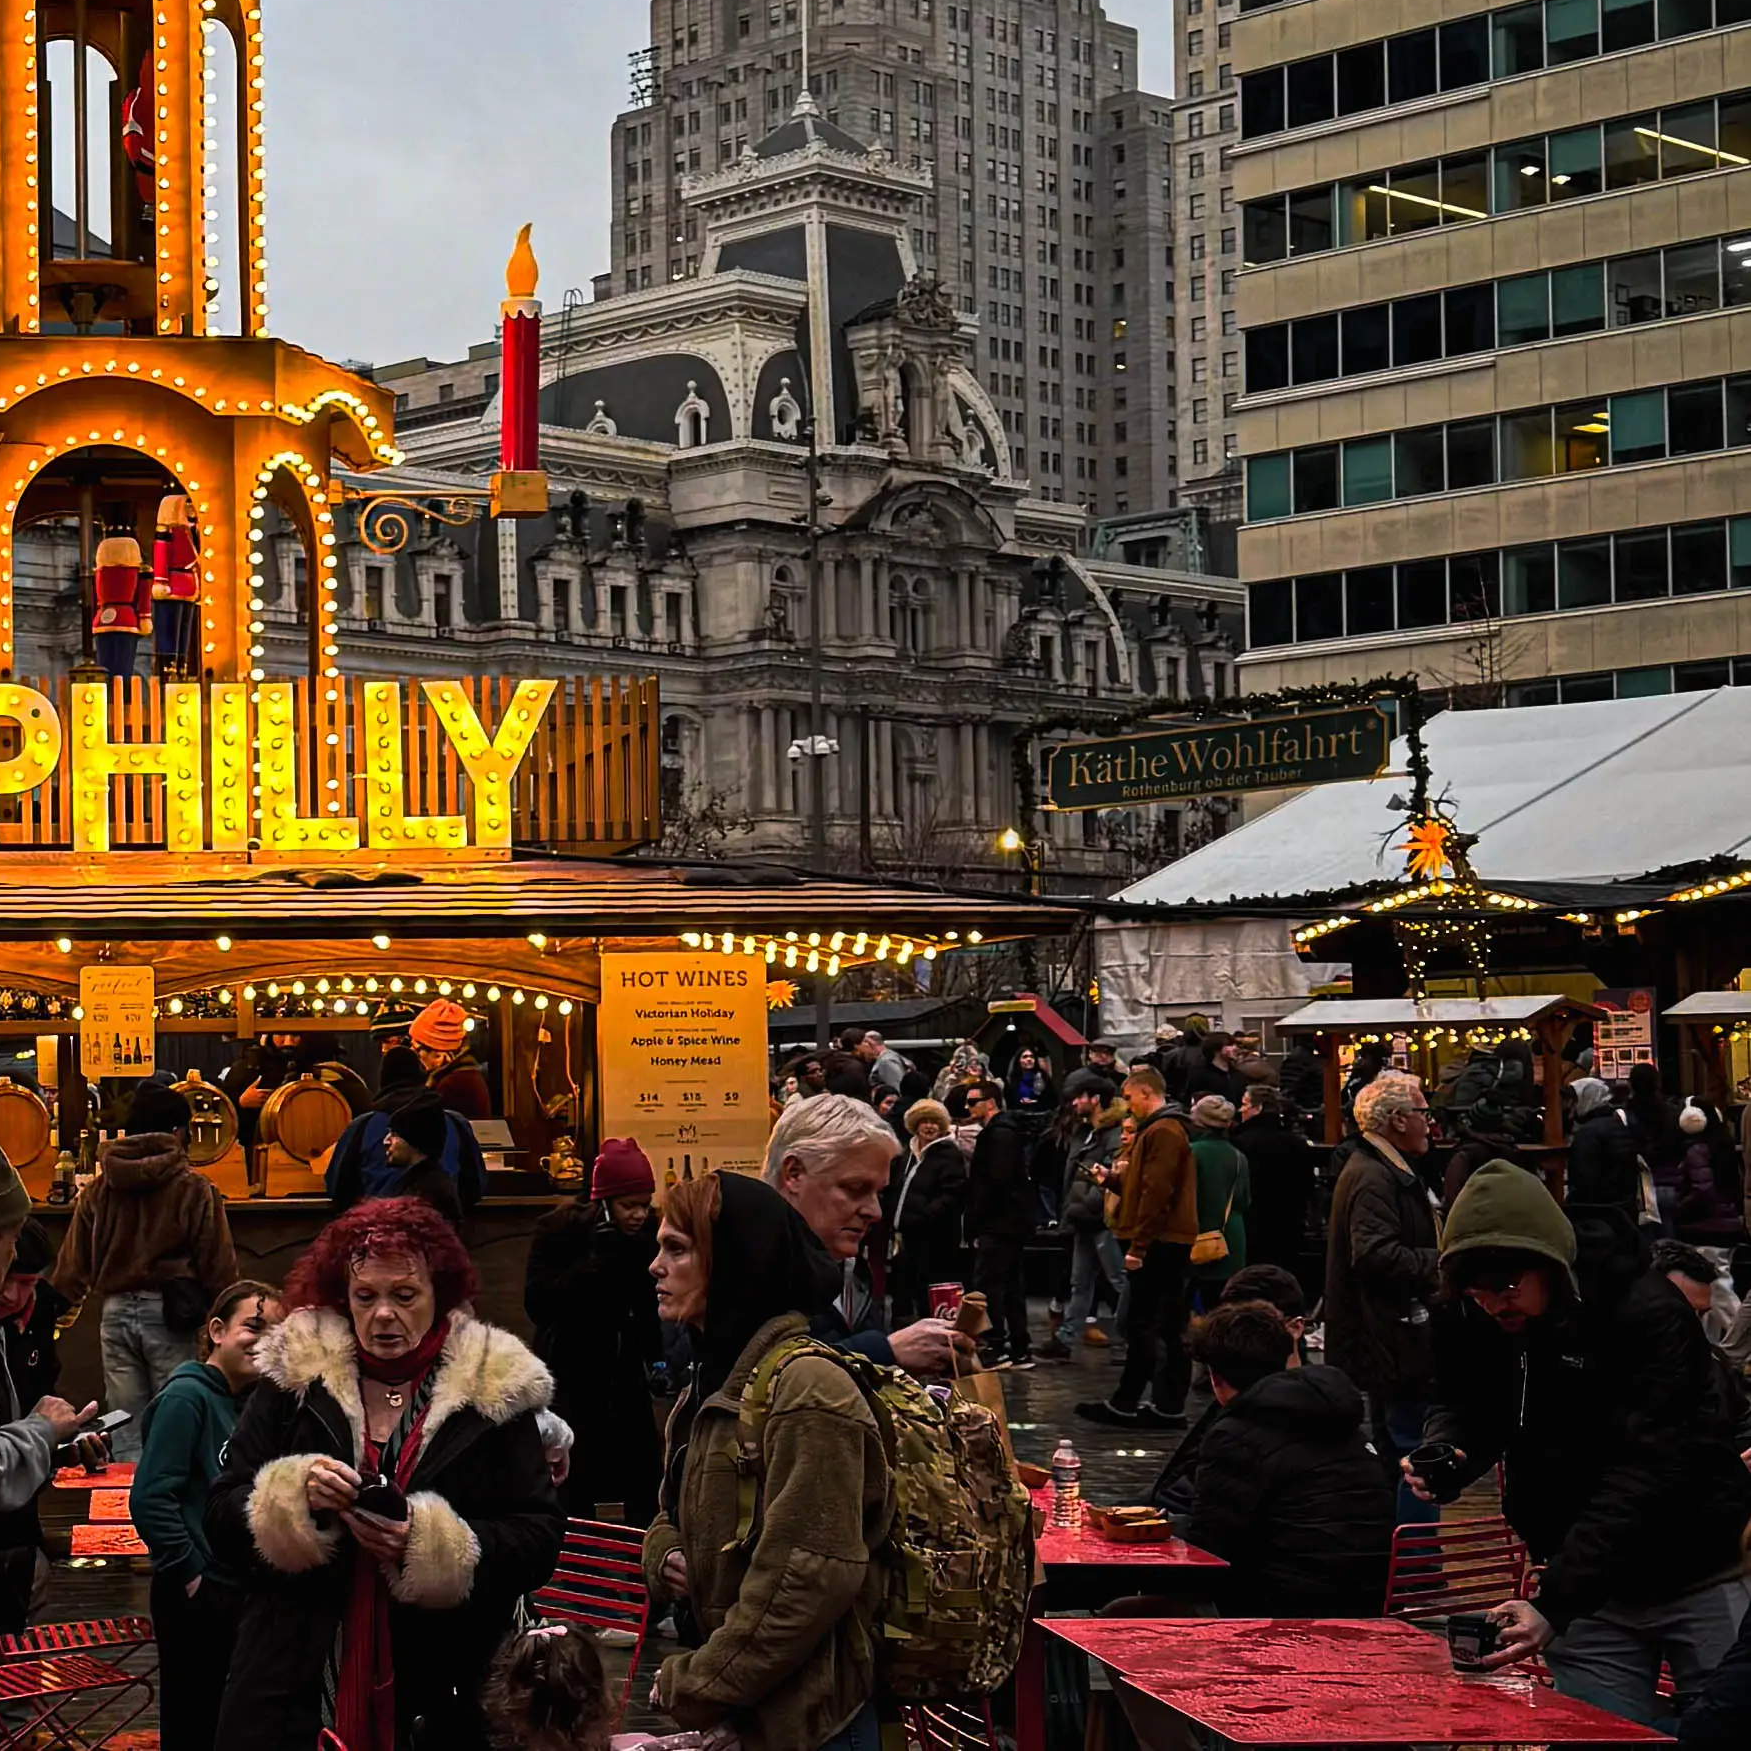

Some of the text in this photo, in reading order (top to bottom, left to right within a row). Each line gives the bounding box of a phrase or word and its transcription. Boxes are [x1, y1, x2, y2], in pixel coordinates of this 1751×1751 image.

[1069, 723, 1363, 787] Käthe Wohlfahrt
[1122, 768, 1302, 798] Rothenburg ob der Tauber
[621, 970, 748, 988] HOT WINES
[635, 1008, 735, 1020] Victorian Holiday
[631, 1035, 741, 1047] Apple & Spice Wine
[650, 1055, 722, 1068] Honey Mead
